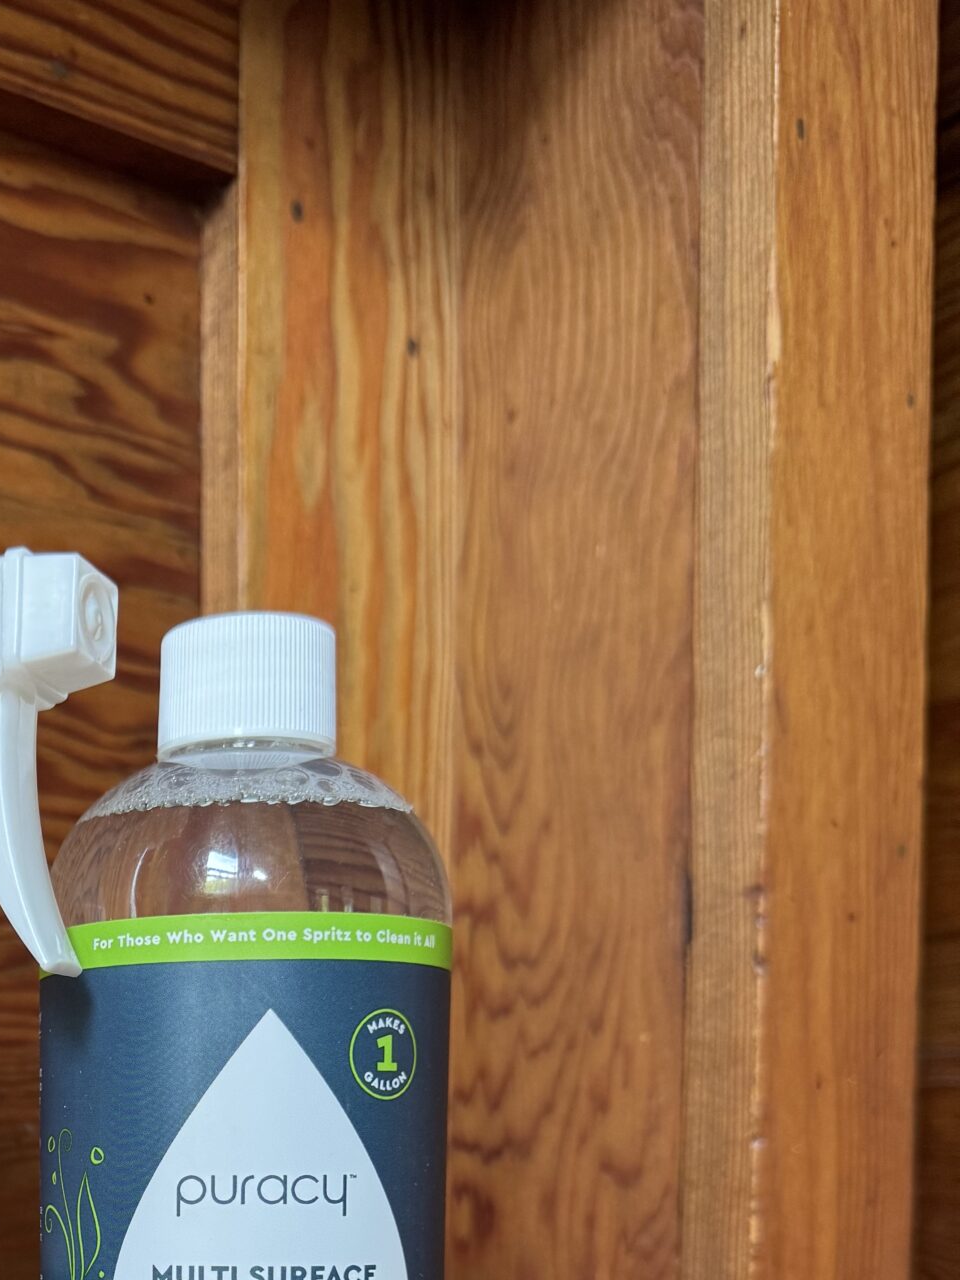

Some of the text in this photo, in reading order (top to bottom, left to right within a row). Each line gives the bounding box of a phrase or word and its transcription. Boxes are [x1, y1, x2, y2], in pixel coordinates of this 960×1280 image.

[93, 927, 435, 950] For Those Who Want One Spritz to Clean it All
[366, 1017, 407, 1035] MAKES
[376, 1035, 398, 1071] 1
[363, 1071, 407, 1091] GALLON
